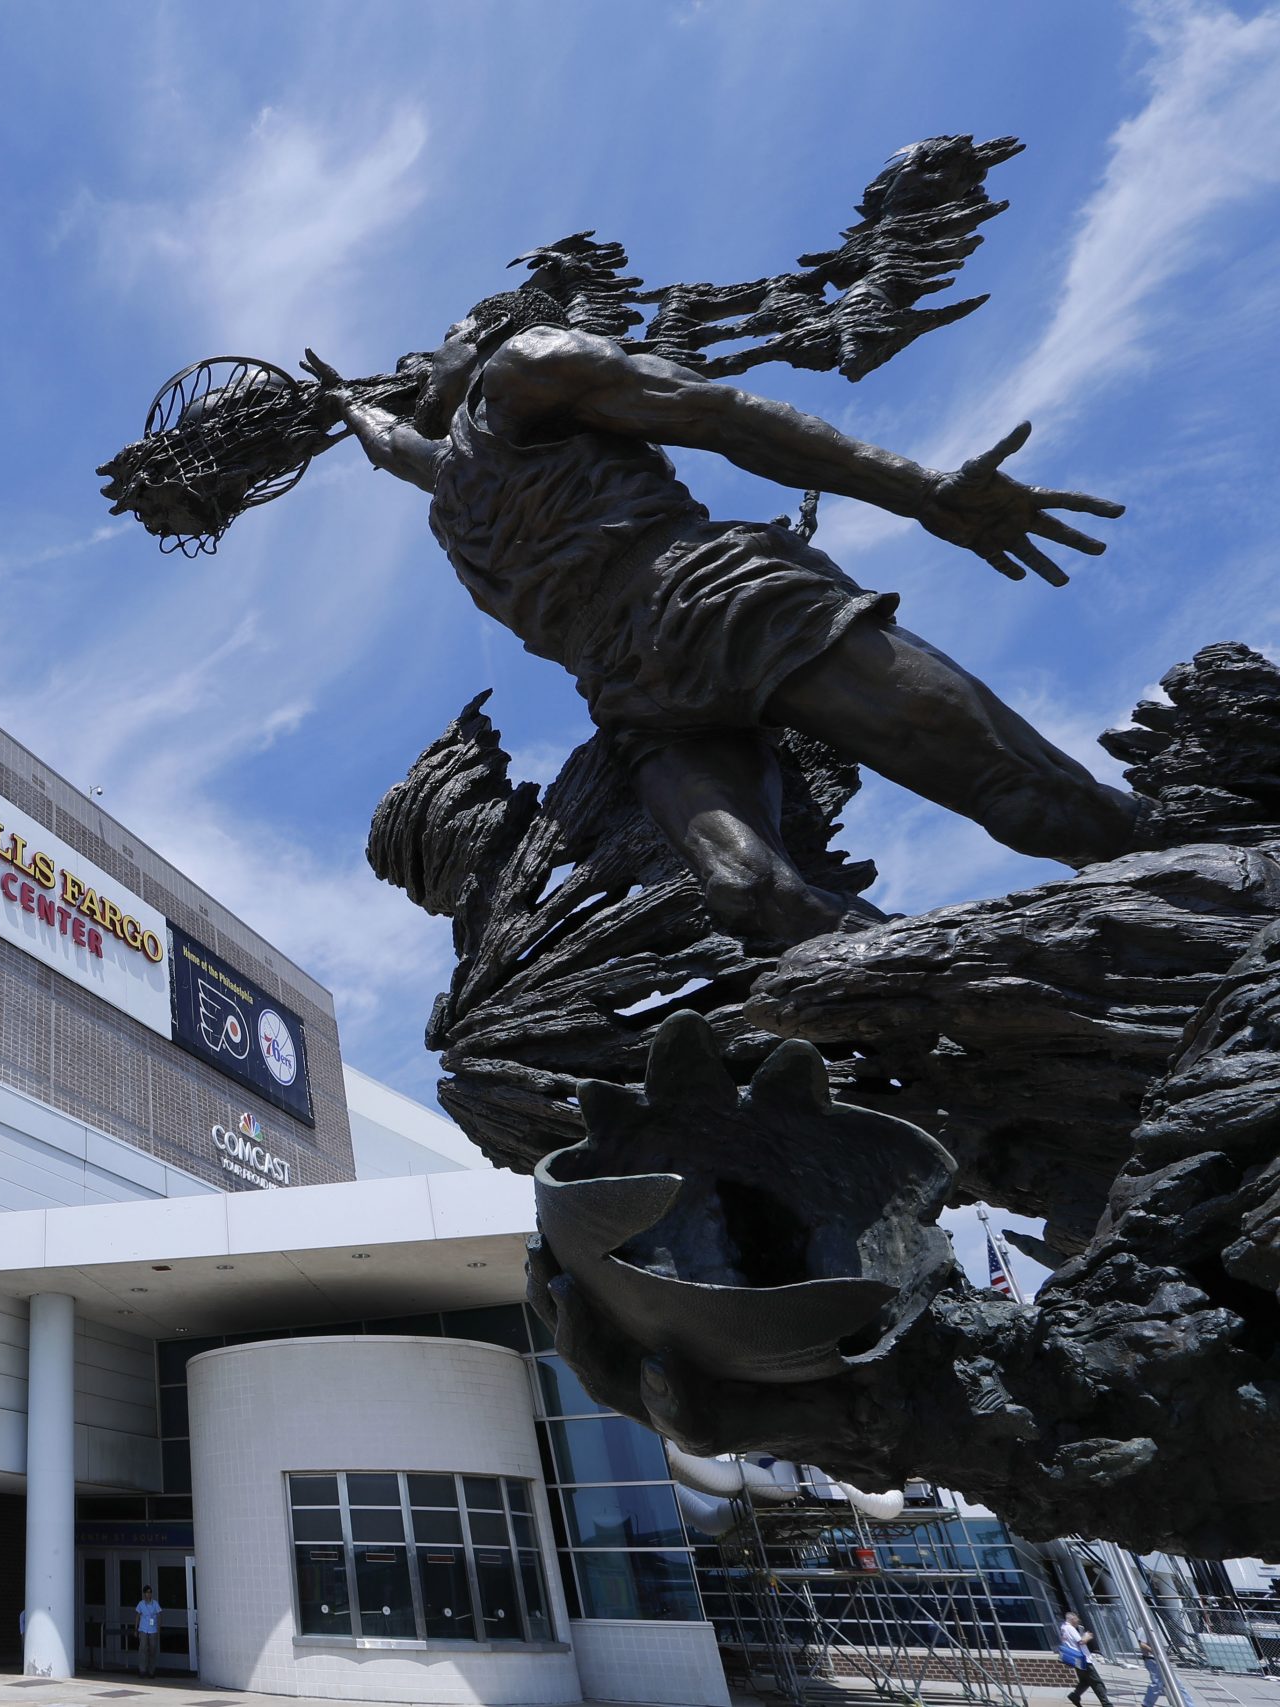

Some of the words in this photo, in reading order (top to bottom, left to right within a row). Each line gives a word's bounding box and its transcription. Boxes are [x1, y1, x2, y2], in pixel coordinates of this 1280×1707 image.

[1, 872, 103, 959] CENTER
[60, 868, 164, 963] FARGO
[182, 945, 200, 966] Home
[208, 964, 219, 979] the
[219, 971, 254, 1005] Philadelphia
[212, 1125, 291, 1185] COMCAST
